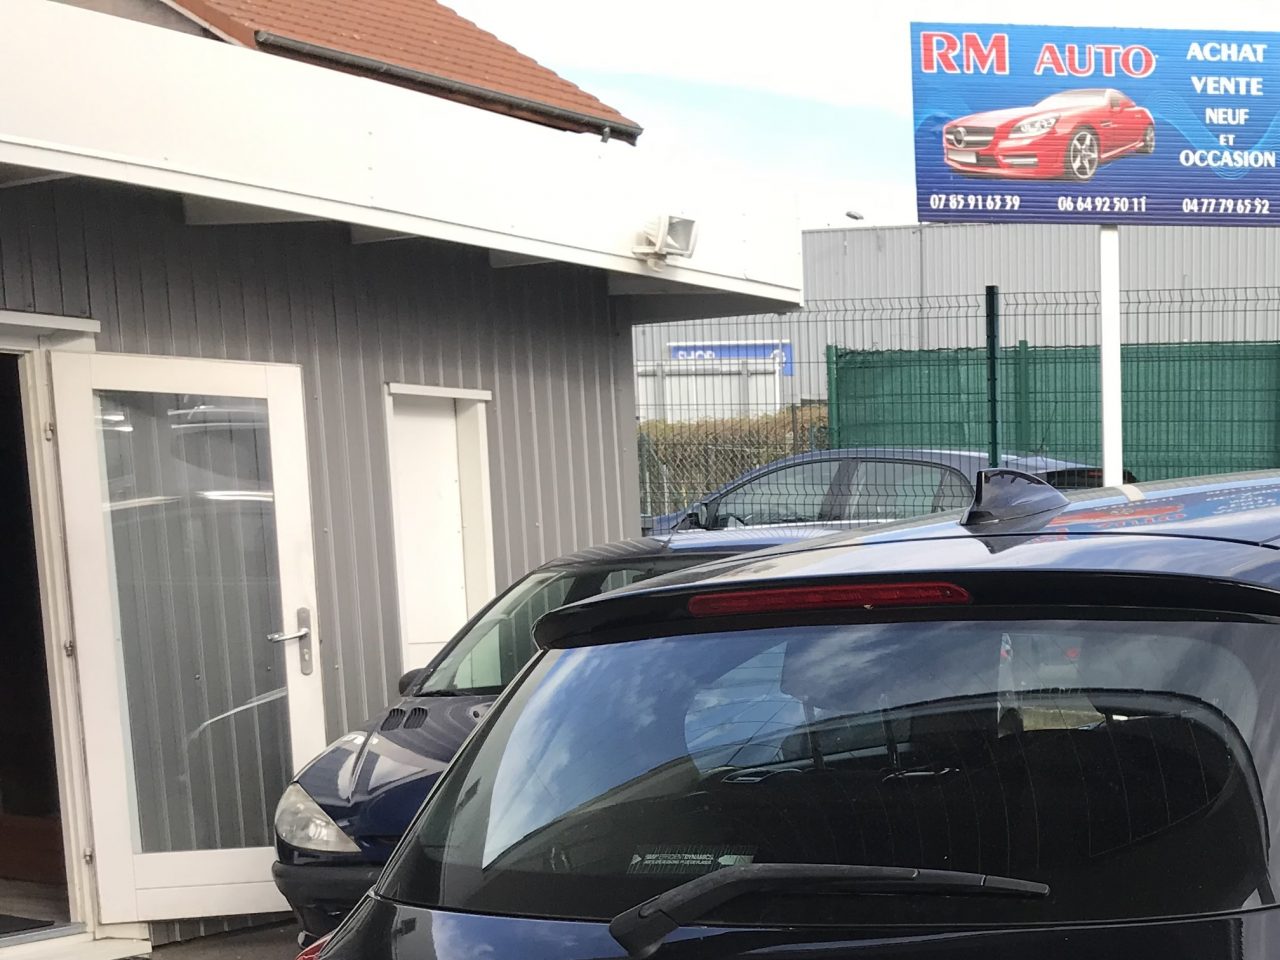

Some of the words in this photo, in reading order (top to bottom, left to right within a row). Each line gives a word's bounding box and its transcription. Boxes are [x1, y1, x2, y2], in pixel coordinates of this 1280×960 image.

[920, 31, 1009, 75] RM
[1034, 43, 1156, 78] AUTO
[1186, 42, 1267, 63] ACHAT
[1191, 76, 1263, 96] VENTE
[1205, 107, 1249, 125] NEUF
[1219, 134, 1235, 146] ET
[1179, 149, 1276, 168] OCCASION
[929, 194, 947, 209] 07
[967, 194, 983, 210] 91
[1058, 196, 1074, 211] 06
[1076, 196, 1093, 211] 64
[1094, 196, 1110, 212] 92
[1182, 198, 1199, 213] 04
[1200, 198, 1217, 213] 77
[1218, 198, 1234, 213] 79
